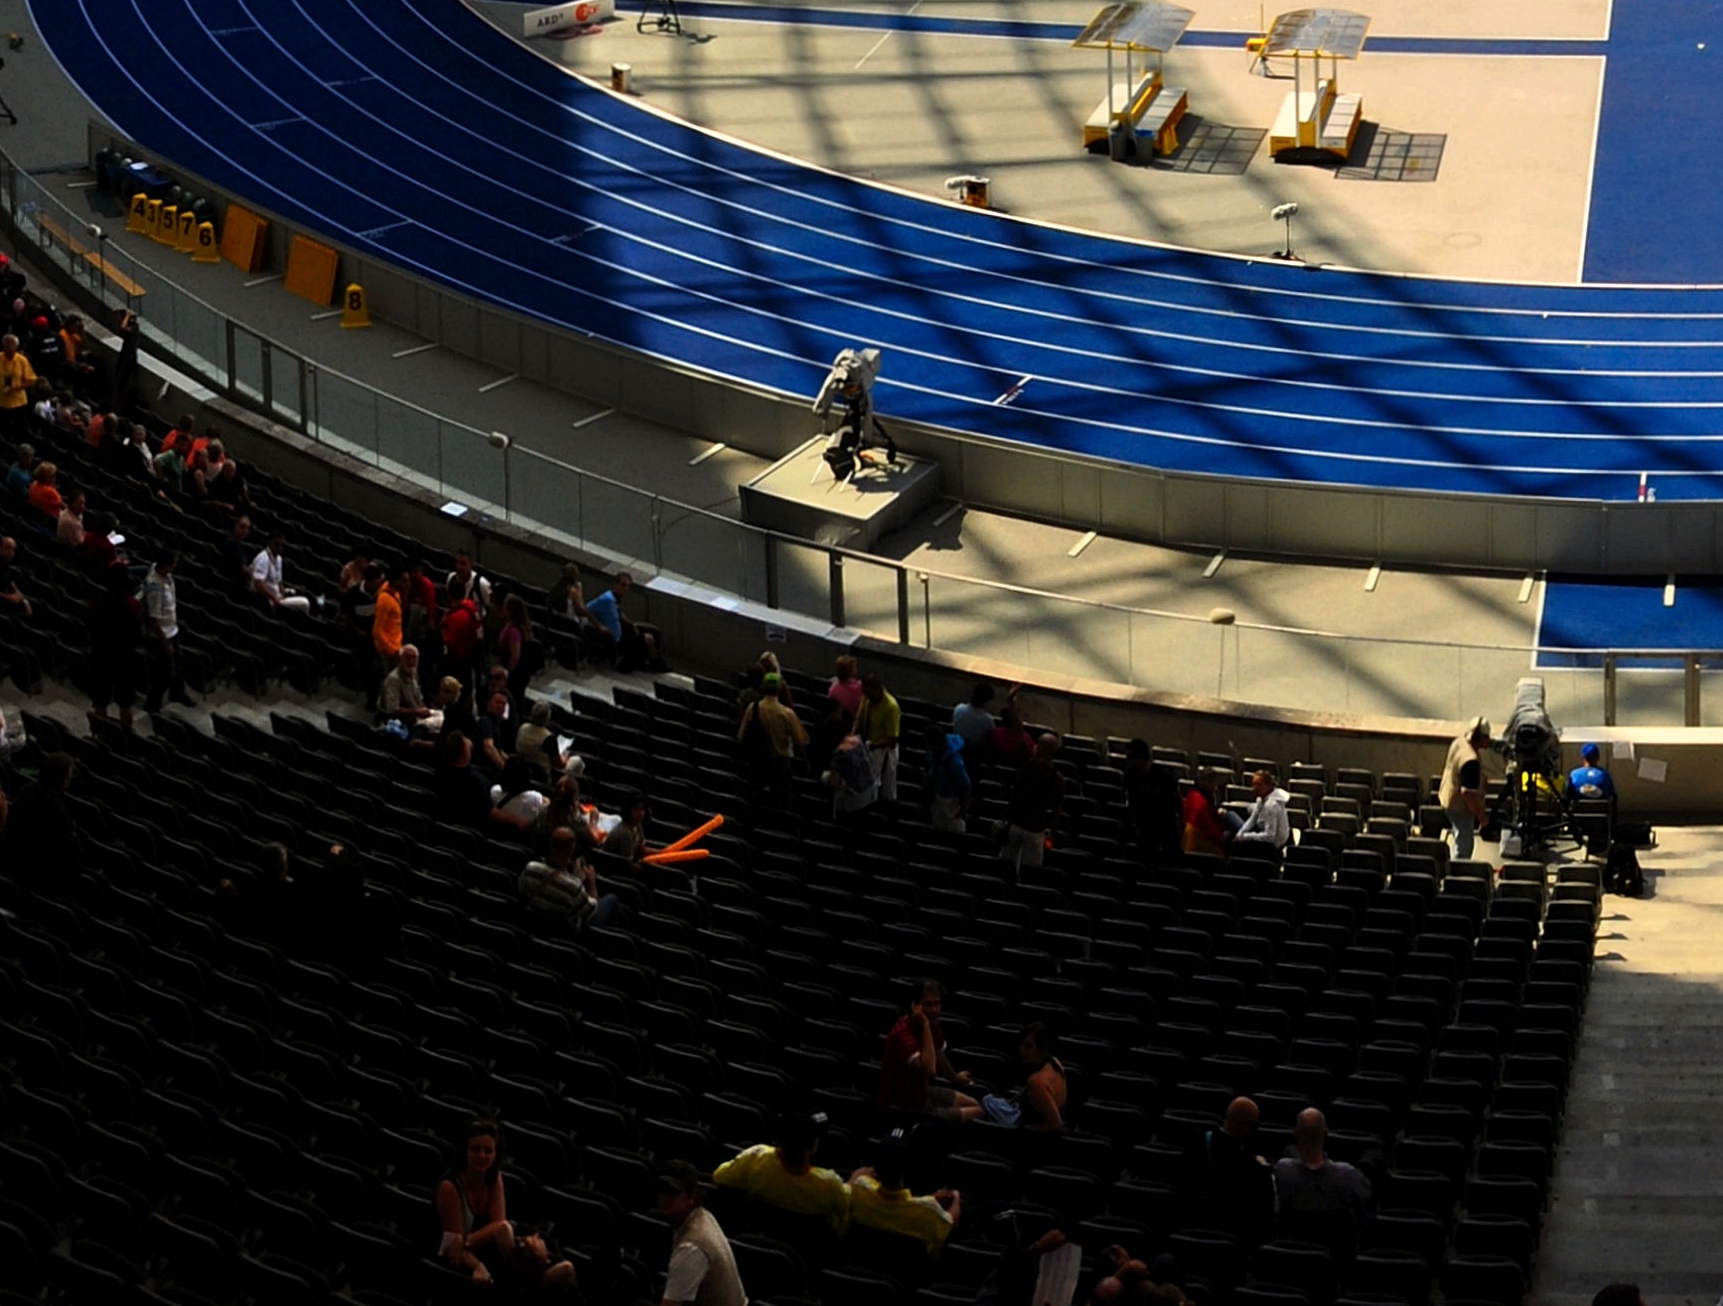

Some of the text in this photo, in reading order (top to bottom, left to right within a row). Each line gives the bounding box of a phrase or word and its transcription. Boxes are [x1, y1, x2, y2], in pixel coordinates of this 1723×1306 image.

[134, 199, 145, 217] 4
[148, 205, 156, 223] 3
[164, 210, 173, 229] 5
[182, 216, 192, 235] 7
[199, 227, 210, 247] 6
